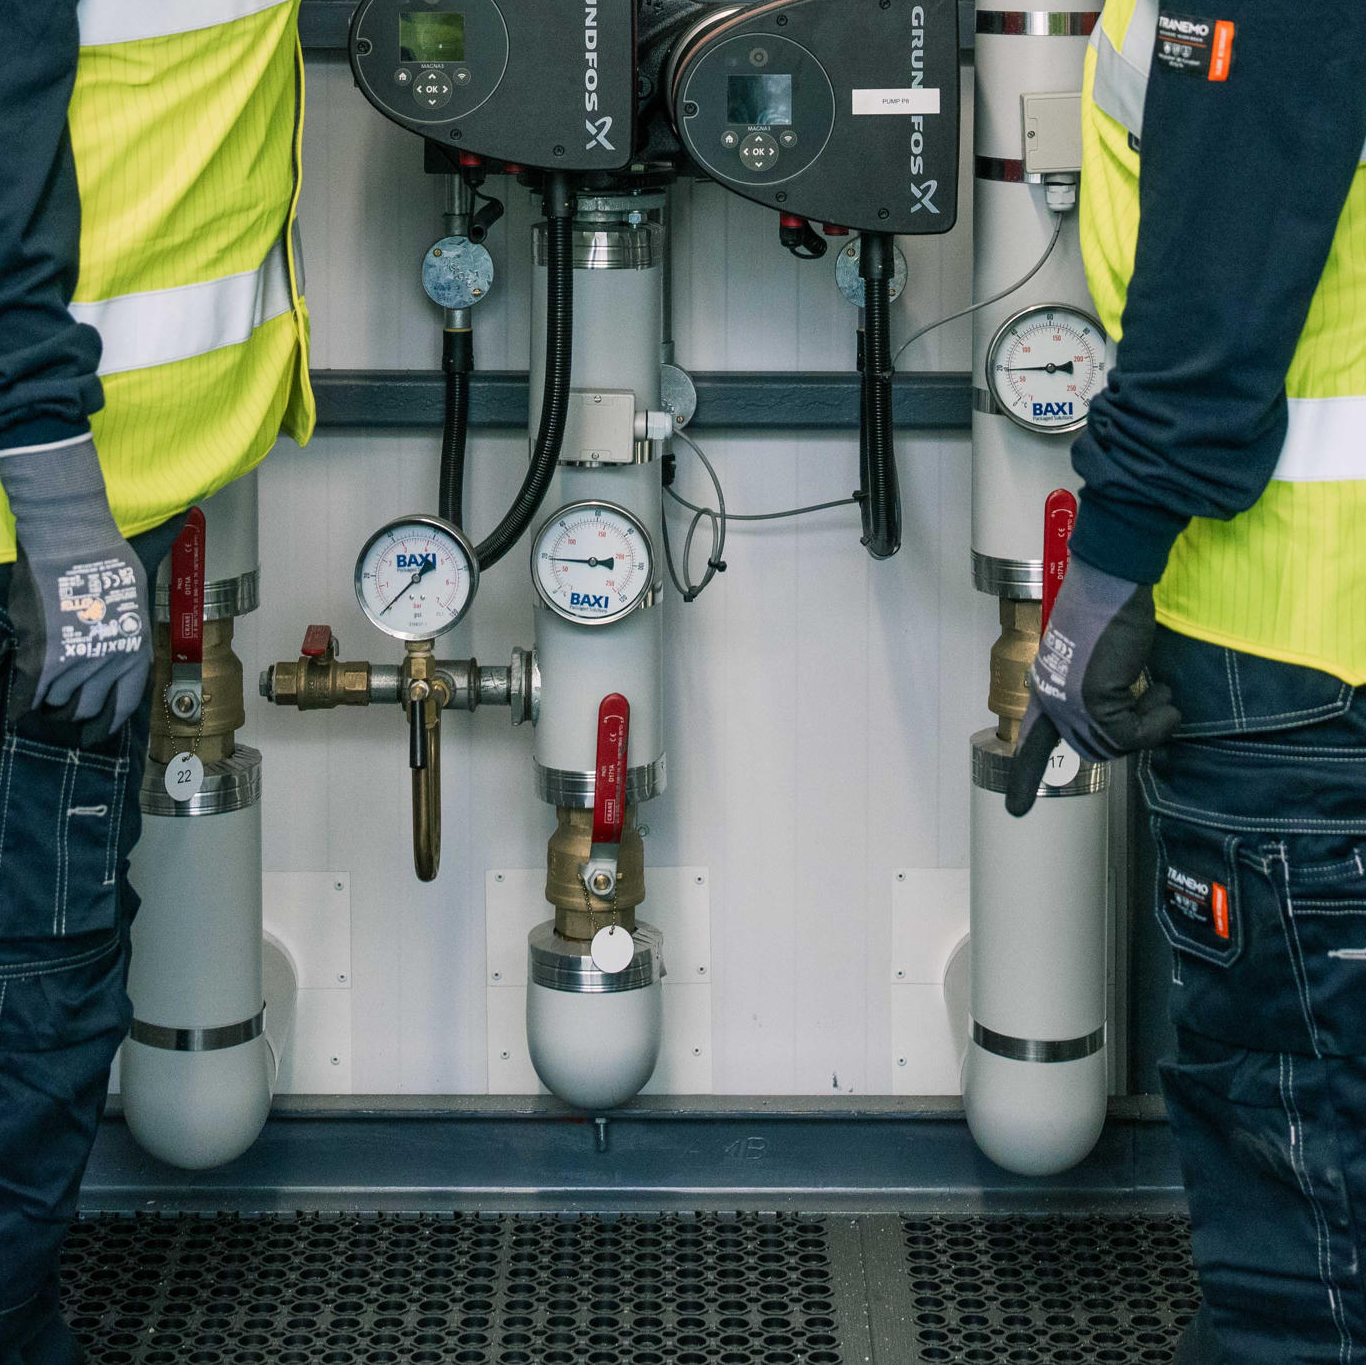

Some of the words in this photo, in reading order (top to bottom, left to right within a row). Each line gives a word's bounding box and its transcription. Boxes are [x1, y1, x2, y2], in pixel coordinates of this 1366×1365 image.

[1159, 16, 1209, 36] TRANEMO
[425, 85, 438, 93] OK
[910, 5, 924, 176] GRUNFOS
[752, 148, 765, 156] OK
[1032, 402, 1073, 416] BAXI
[396, 553, 436, 569] BAXI
[570, 592, 609, 609] BAXI
[65, 636, 142, 658] MaxiFlex
[177, 769, 193, 784] 22
